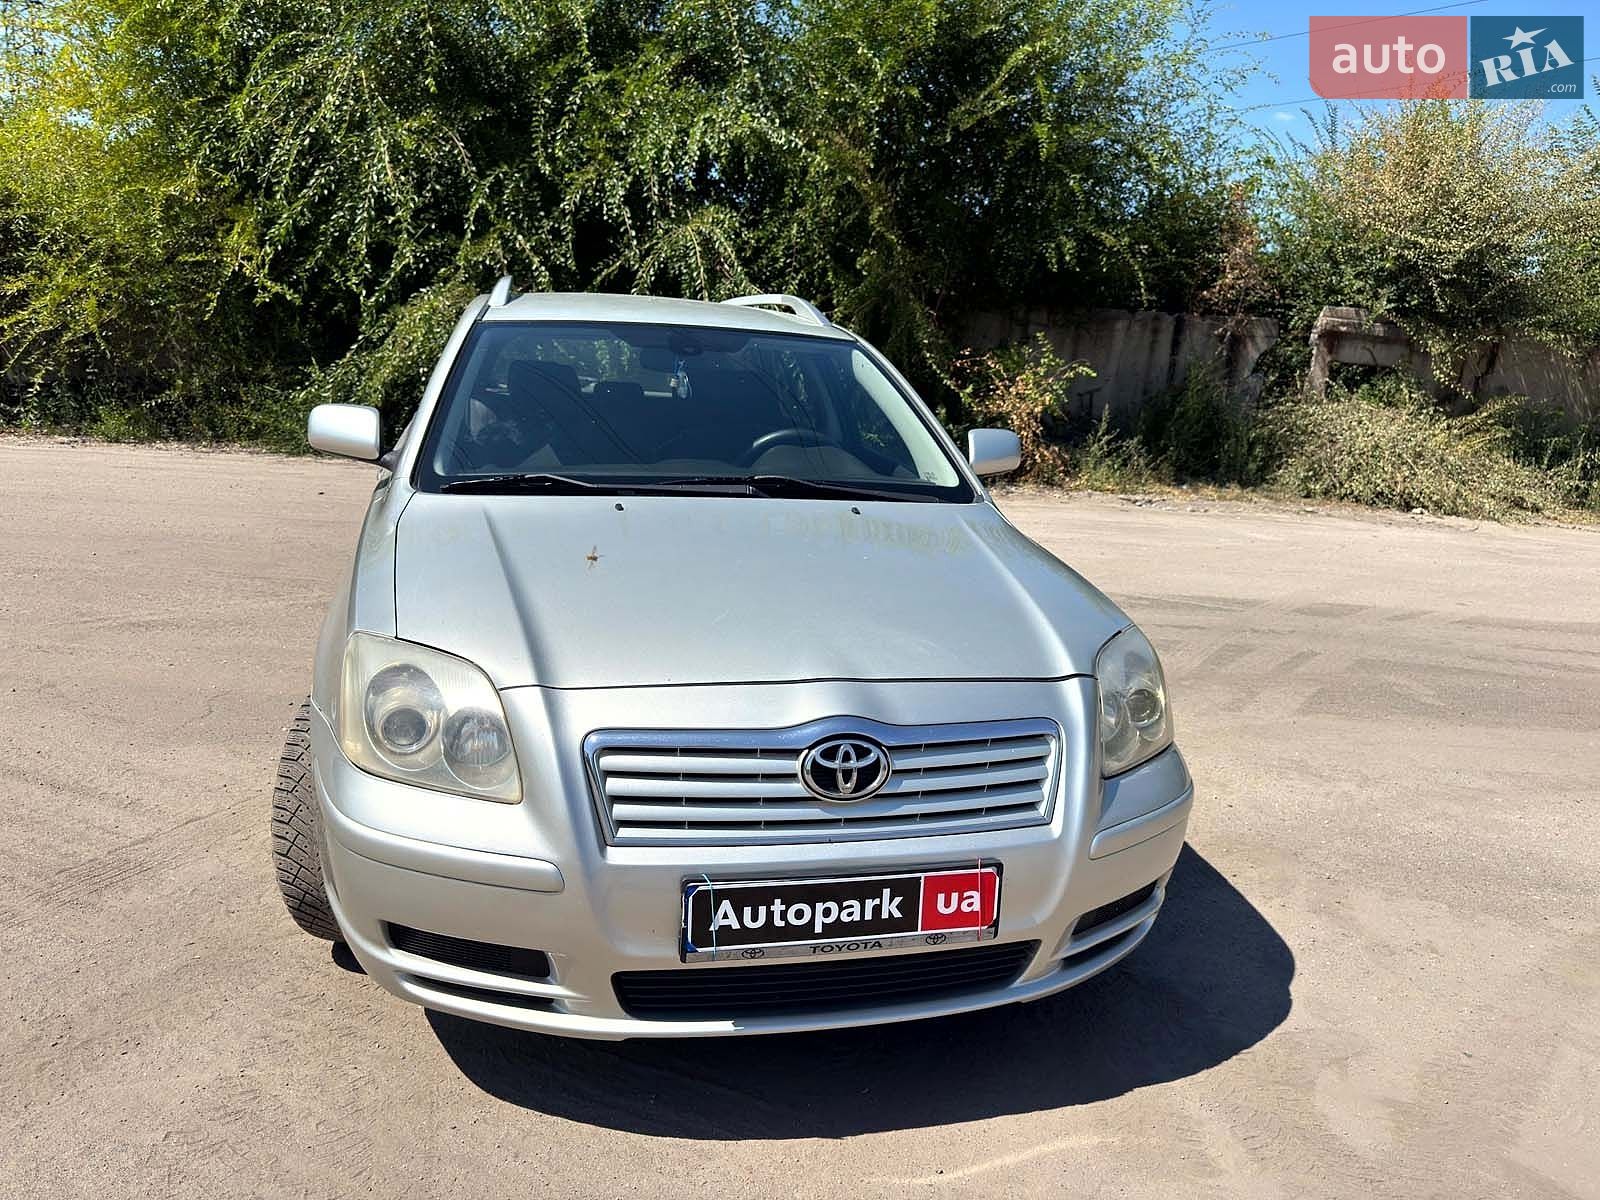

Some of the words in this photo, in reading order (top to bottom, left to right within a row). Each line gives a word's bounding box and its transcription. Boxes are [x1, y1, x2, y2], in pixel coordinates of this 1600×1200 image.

[709, 888, 904, 933] Autopark
[936, 890, 981, 913] ua
[809, 940, 883, 954] TOYOTA
